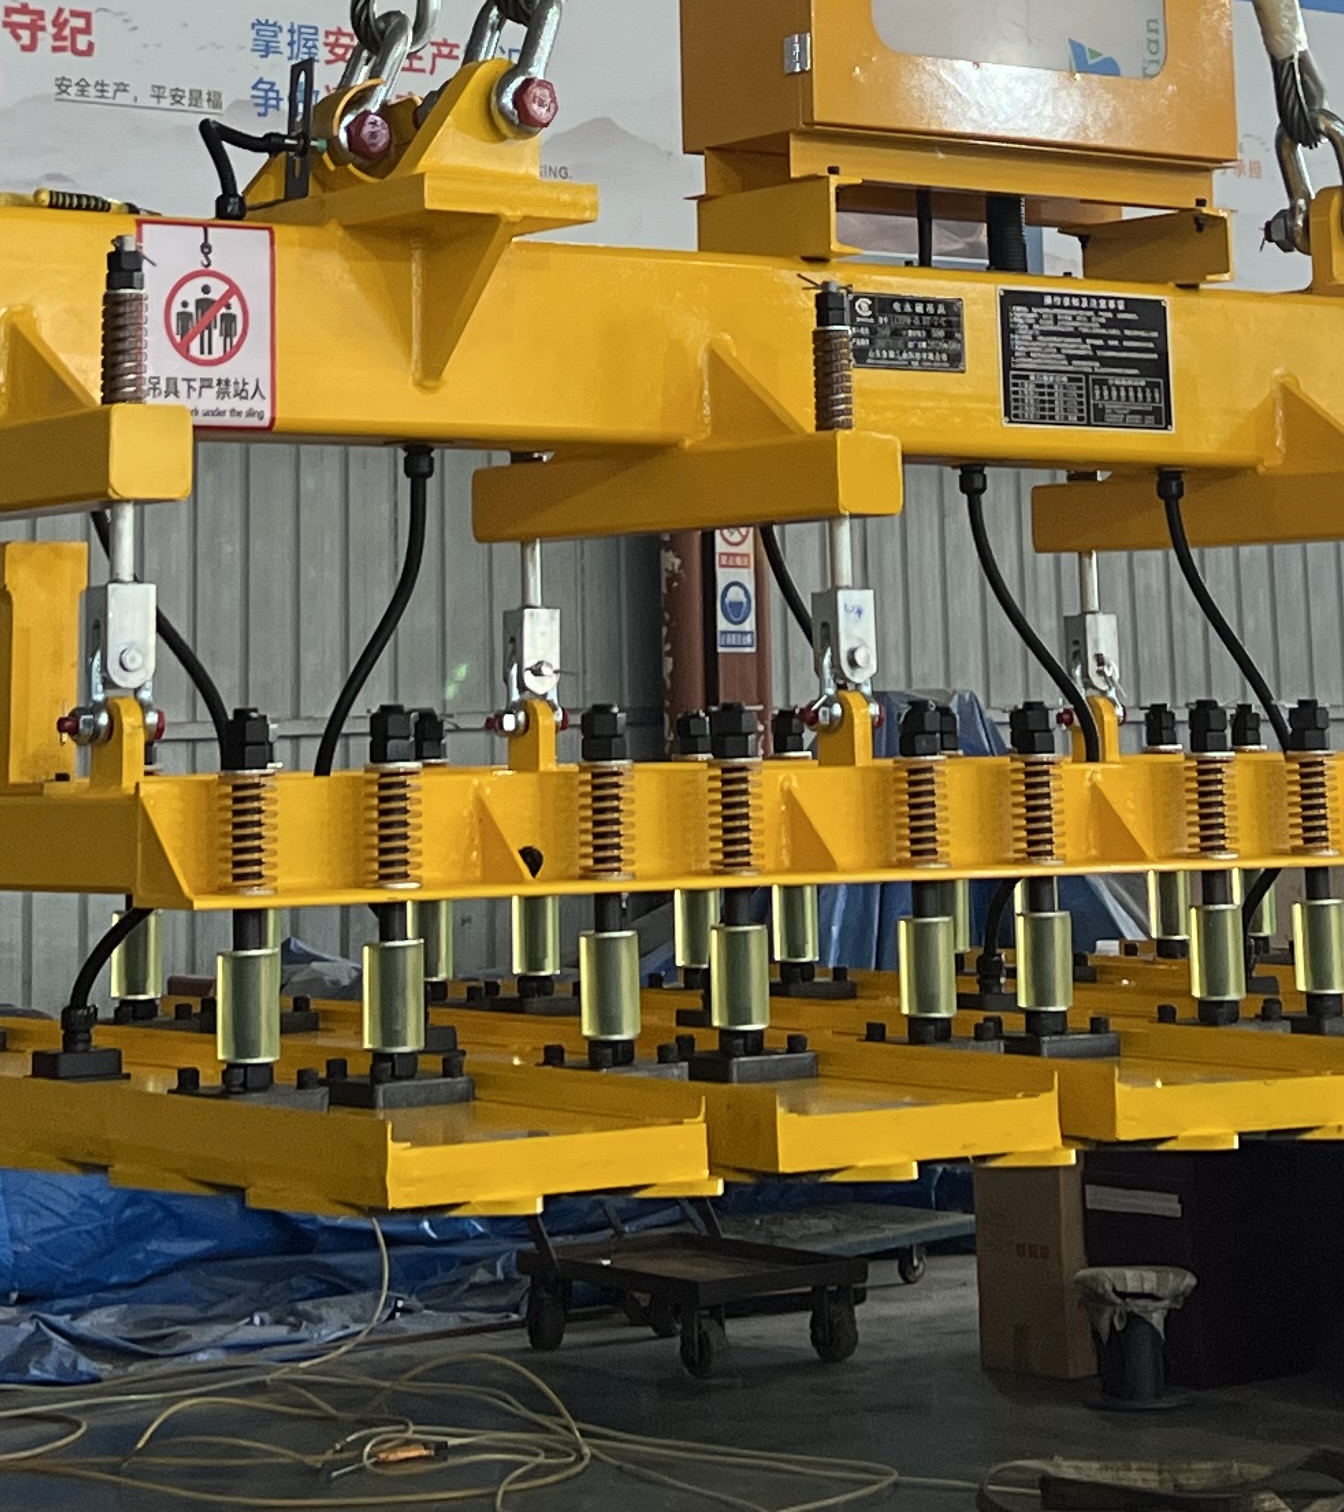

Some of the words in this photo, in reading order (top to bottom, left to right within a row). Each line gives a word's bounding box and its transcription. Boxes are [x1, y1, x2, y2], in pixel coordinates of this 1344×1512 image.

[146, 375, 266, 401] 吊具下严禁站人
